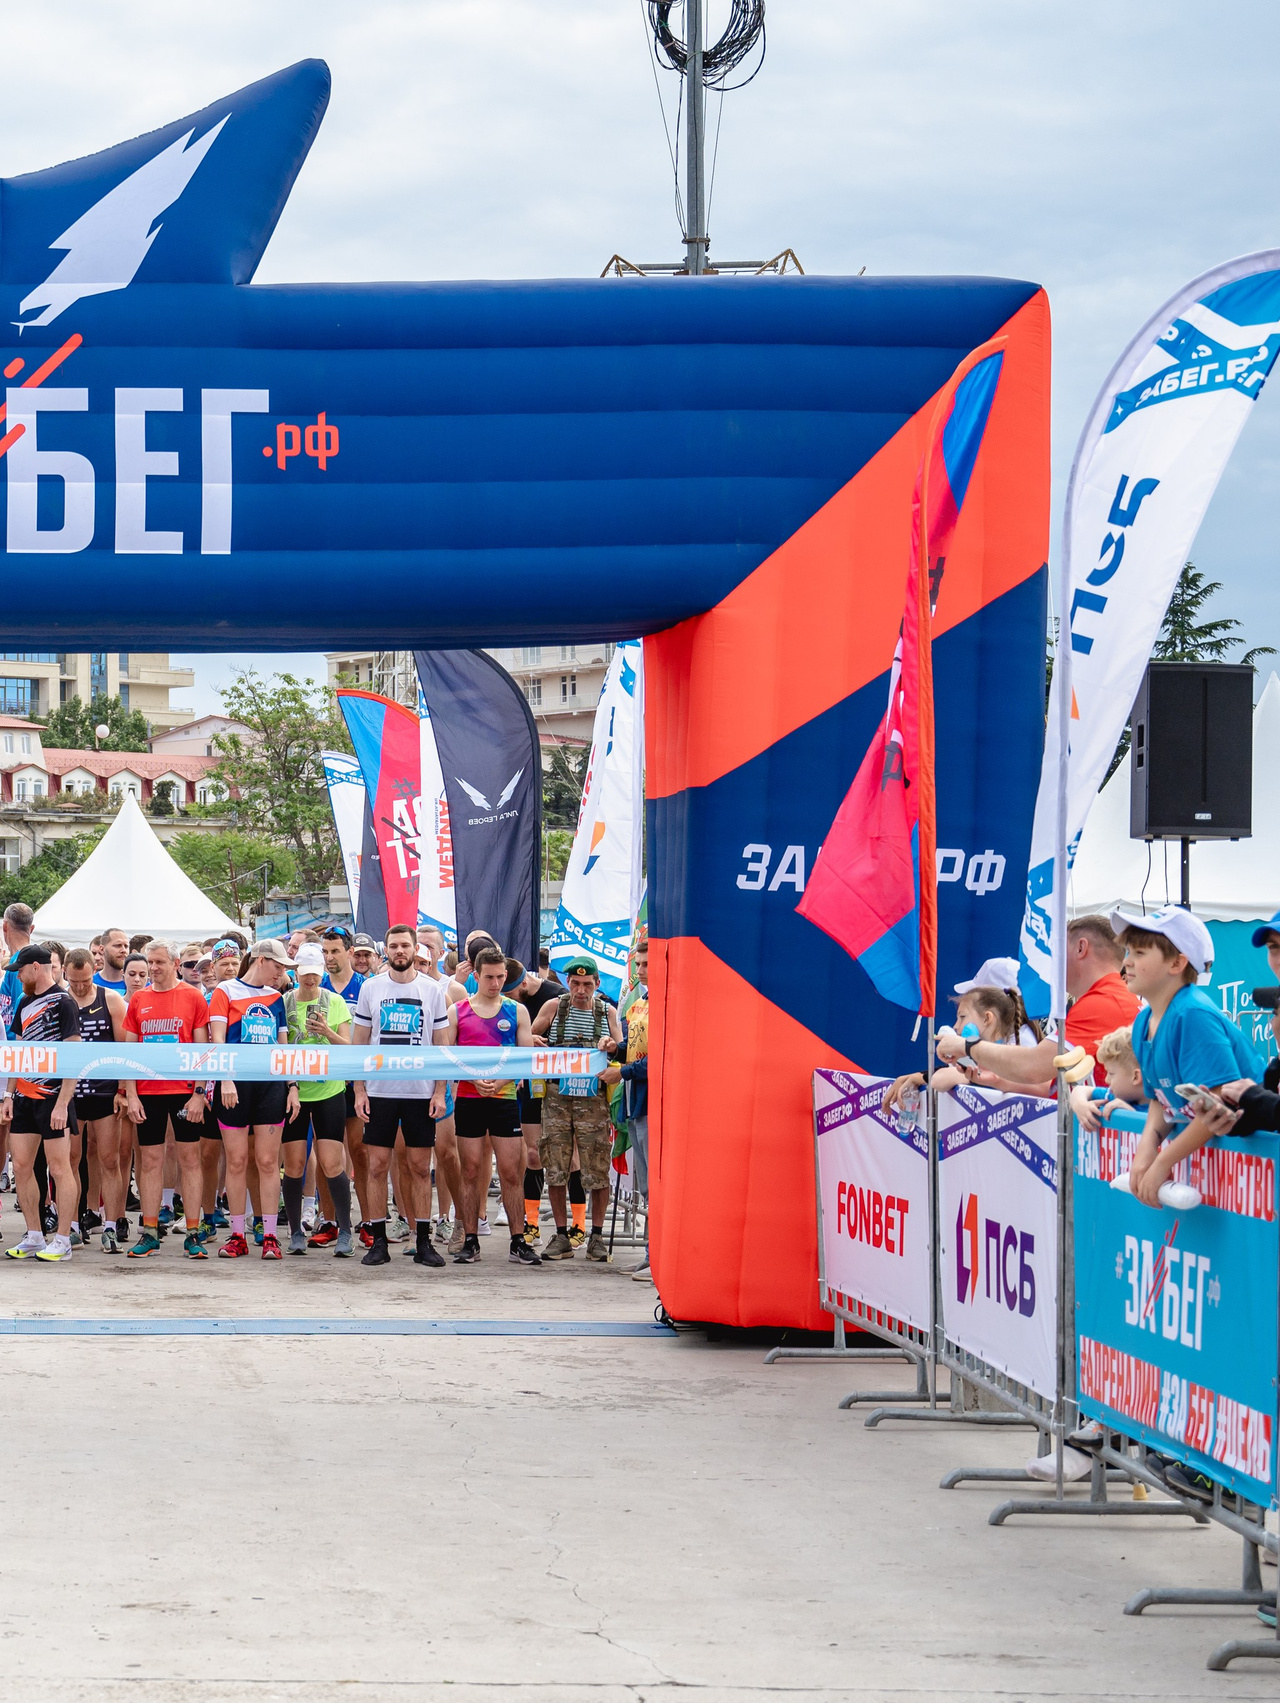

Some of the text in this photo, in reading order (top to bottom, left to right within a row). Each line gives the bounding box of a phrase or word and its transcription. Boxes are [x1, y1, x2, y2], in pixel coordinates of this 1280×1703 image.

[141, 1017, 183, 1034] ФИНИШЁР
[249, 1025, 271, 1035] 40003
[388, 1012, 412, 1023] 40127
[0, 1046, 56, 1073] СТАРТ
[270, 1049, 328, 1075] СТАРТ
[388, 1056, 424, 1069] ПСБ
[531, 1051, 590, 1075] СТАРТ
[568, 1077, 590, 1088] 40187
[823, 1102, 852, 1127] ЗАБЕГ.РФ
[987, 1101, 1024, 1133] ЗАБЕГ.РФ
[947, 1122, 978, 1151] ЗАБЕГ.РФ
[837, 1181, 909, 1257] FONBET
[985, 1218, 1036, 1318] ПСБ
[1079, 1334, 1272, 1484] #АДРЕНАЛИН #ЗАБЕГ #ЦЕЛЬ
